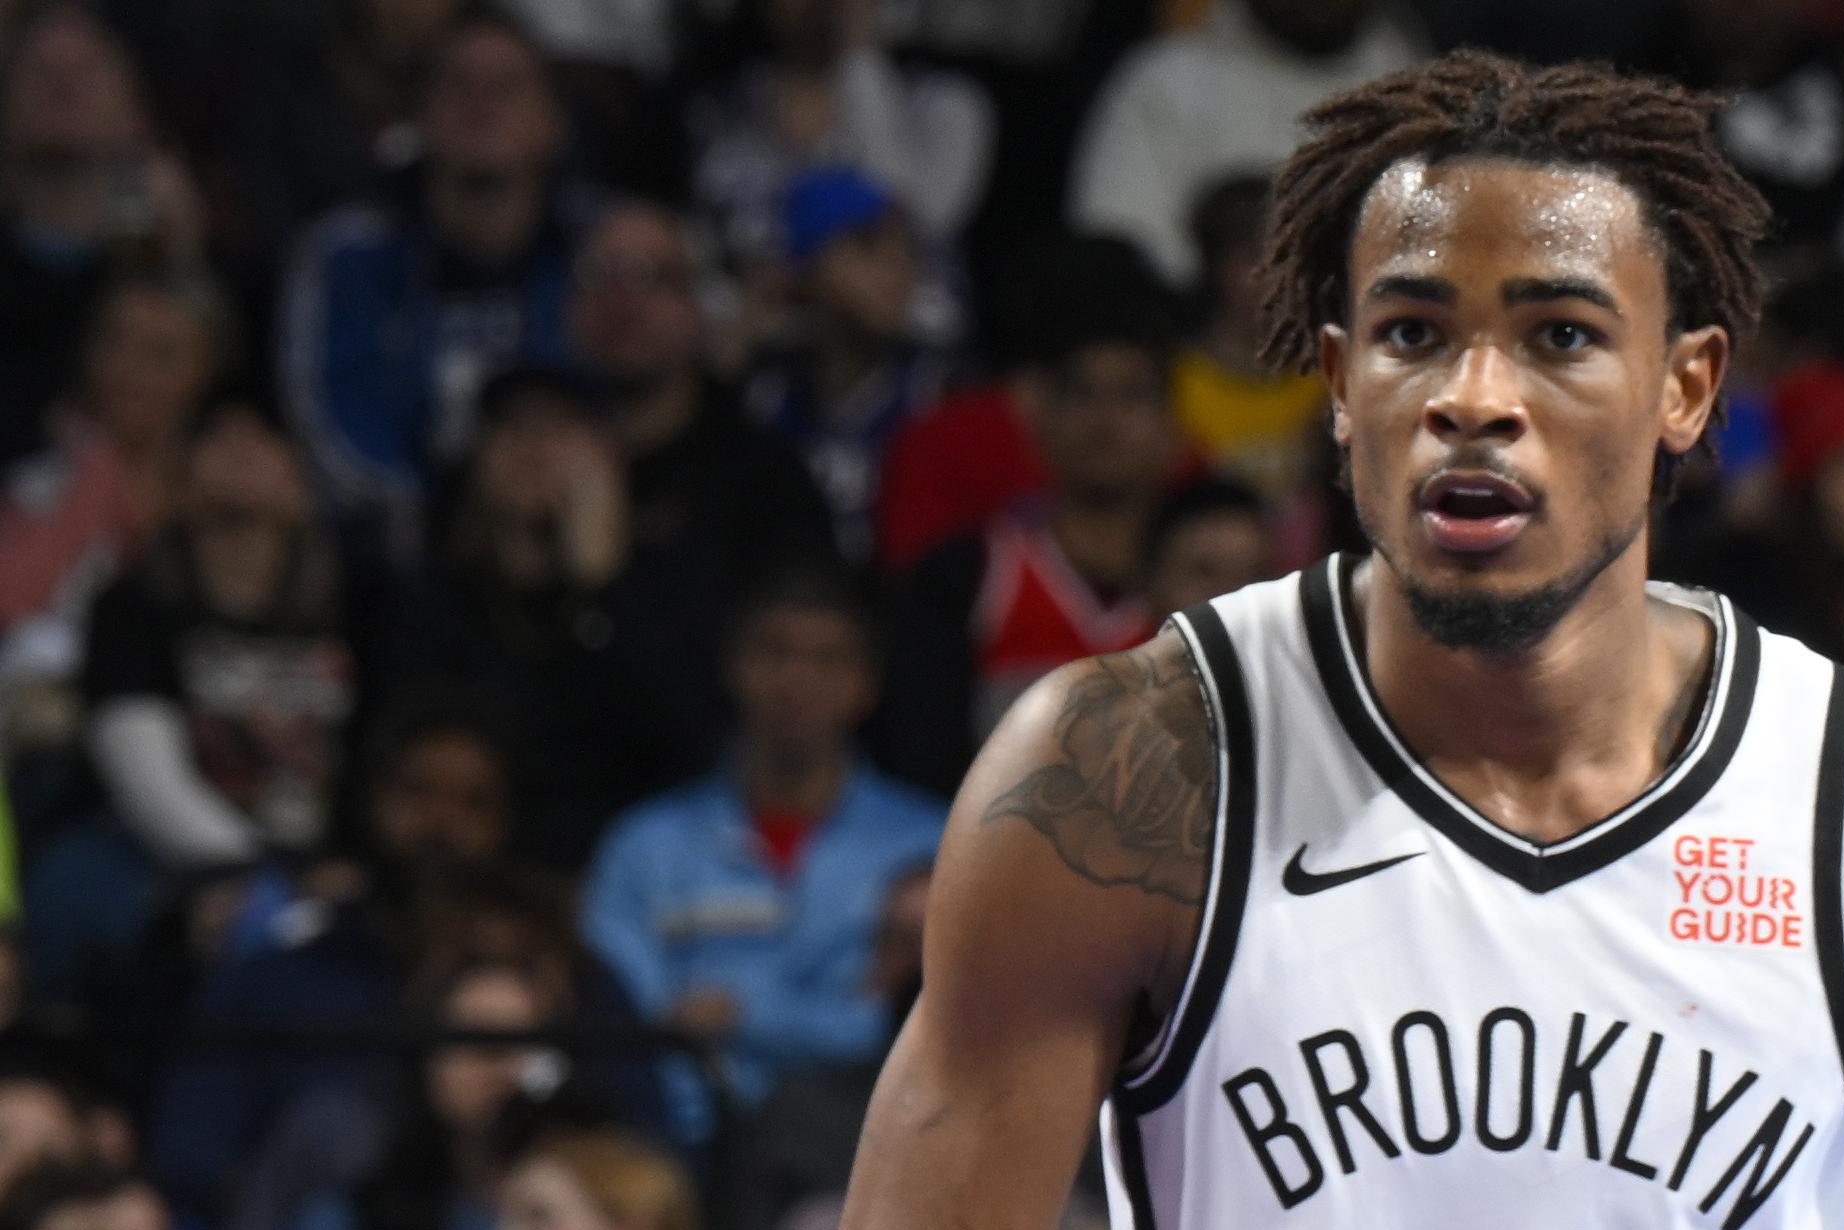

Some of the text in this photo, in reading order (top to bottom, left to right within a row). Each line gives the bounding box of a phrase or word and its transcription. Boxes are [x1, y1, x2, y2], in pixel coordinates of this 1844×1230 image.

[1674, 835, 1755, 870] GET
[1674, 871, 1797, 910] YOUR
[1669, 907, 1803, 948] GUIDE
